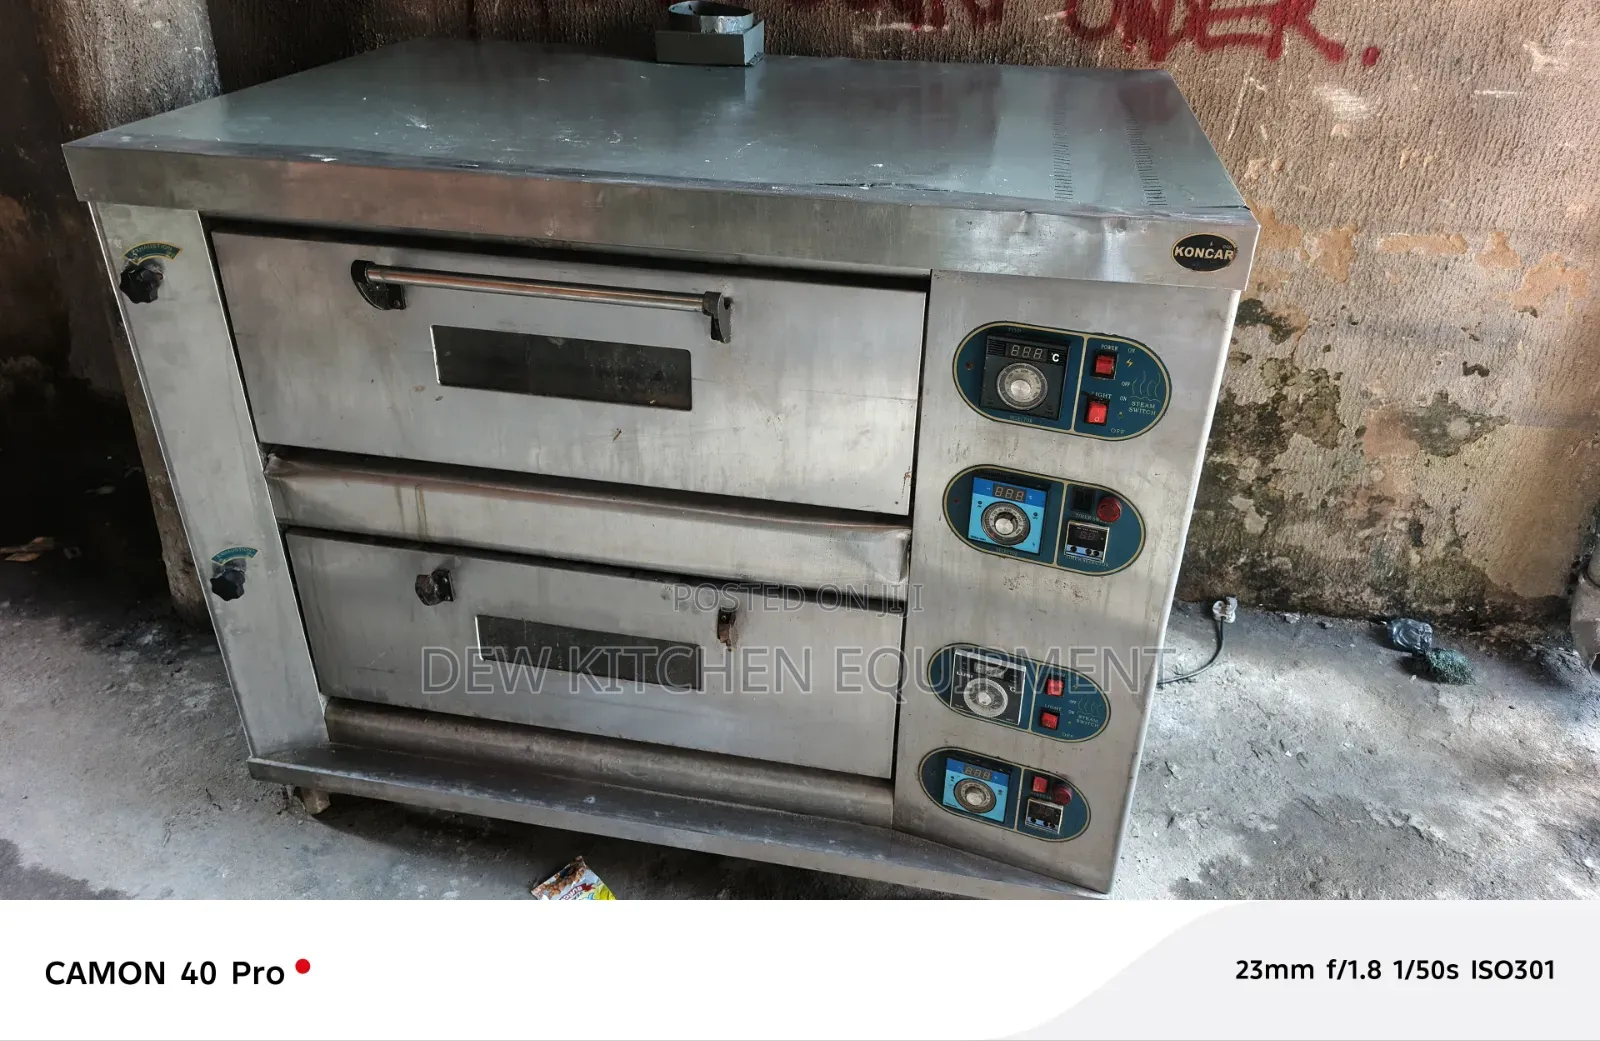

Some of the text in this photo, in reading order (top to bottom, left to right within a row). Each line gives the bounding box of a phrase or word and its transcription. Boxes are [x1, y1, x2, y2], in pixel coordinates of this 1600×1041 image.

[1101, 343, 1119, 351] POWER
[1091, 390, 1113, 399] IGHT
[1131, 401, 1156, 409] STEAM
[1128, 407, 1157, 416] SWITCH
[1110, 427, 1126, 435] OFF
[1076, 718, 1100, 728] SWITCH
